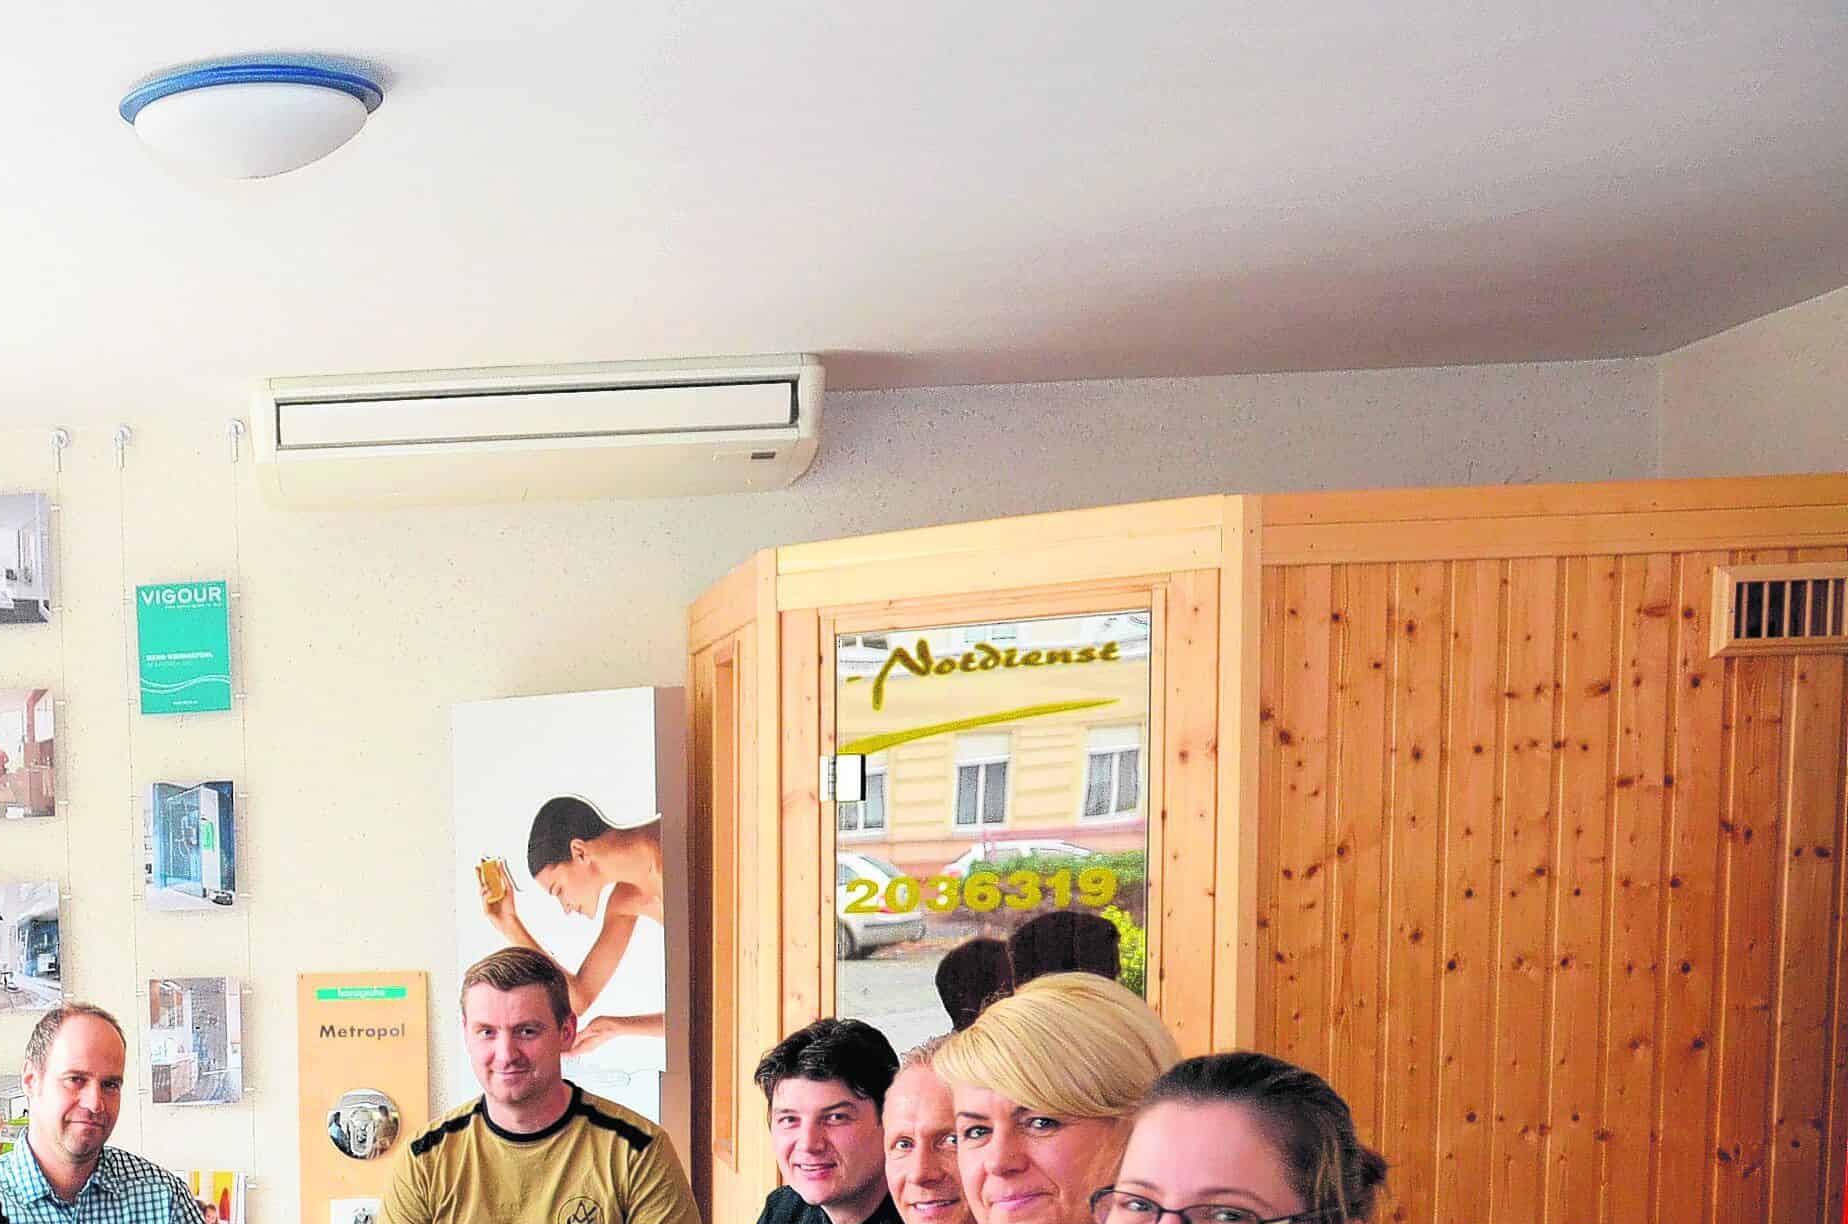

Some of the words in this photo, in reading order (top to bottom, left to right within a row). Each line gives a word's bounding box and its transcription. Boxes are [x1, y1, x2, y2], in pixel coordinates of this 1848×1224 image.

[141, 586, 222, 605] VIGOUR
[871, 639, 1121, 711] Notdienst
[843, 867, 1119, 915] 2036319
[319, 1023, 406, 1040] Metropol
